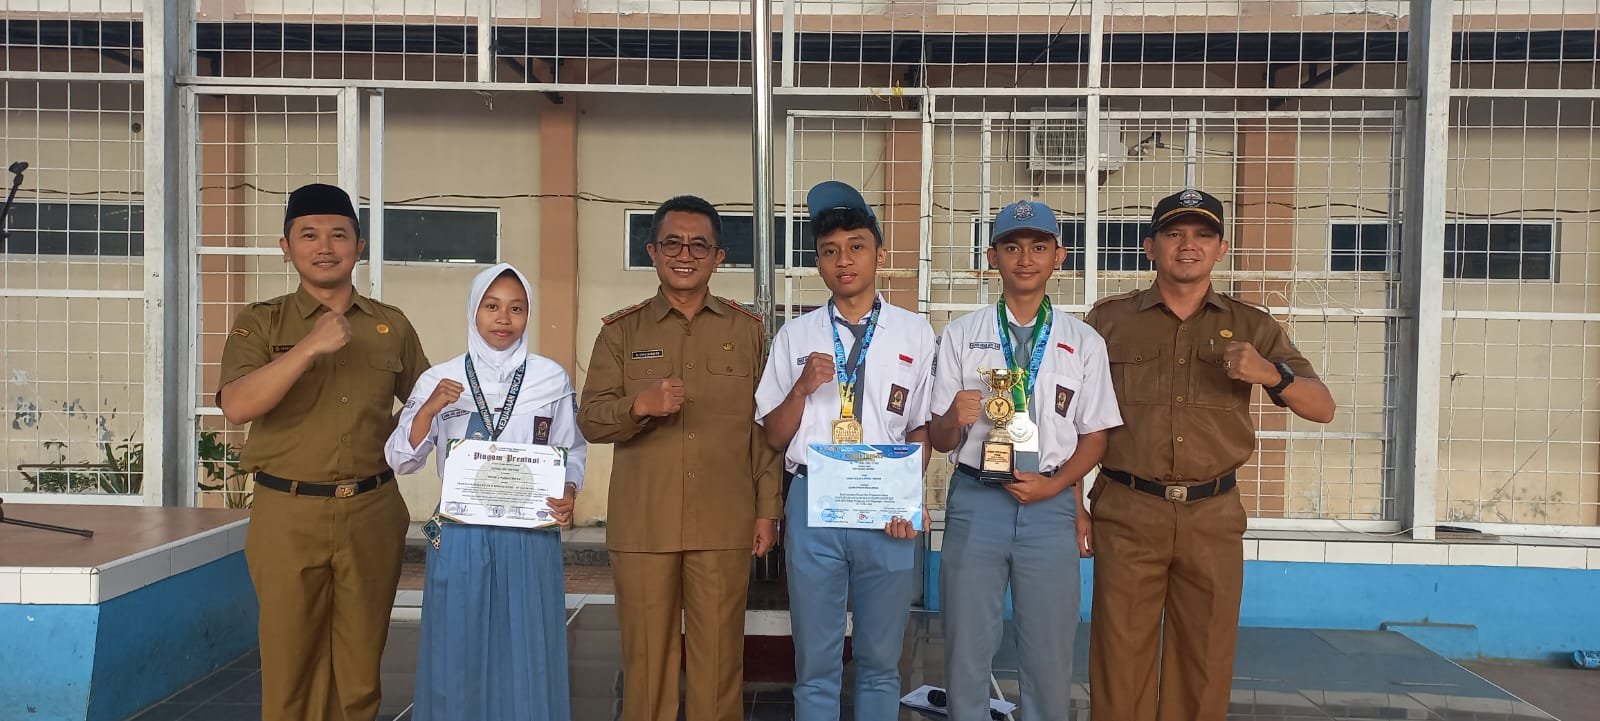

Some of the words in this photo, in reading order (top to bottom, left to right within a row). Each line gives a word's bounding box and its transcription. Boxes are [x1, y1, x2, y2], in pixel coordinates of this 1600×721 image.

[498, 394, 516, 431] KEJUARAAN
[510, 373, 523, 394] PENCAK
[474, 452, 503, 462] Piagam
[506, 454, 540, 464] Prestasi
